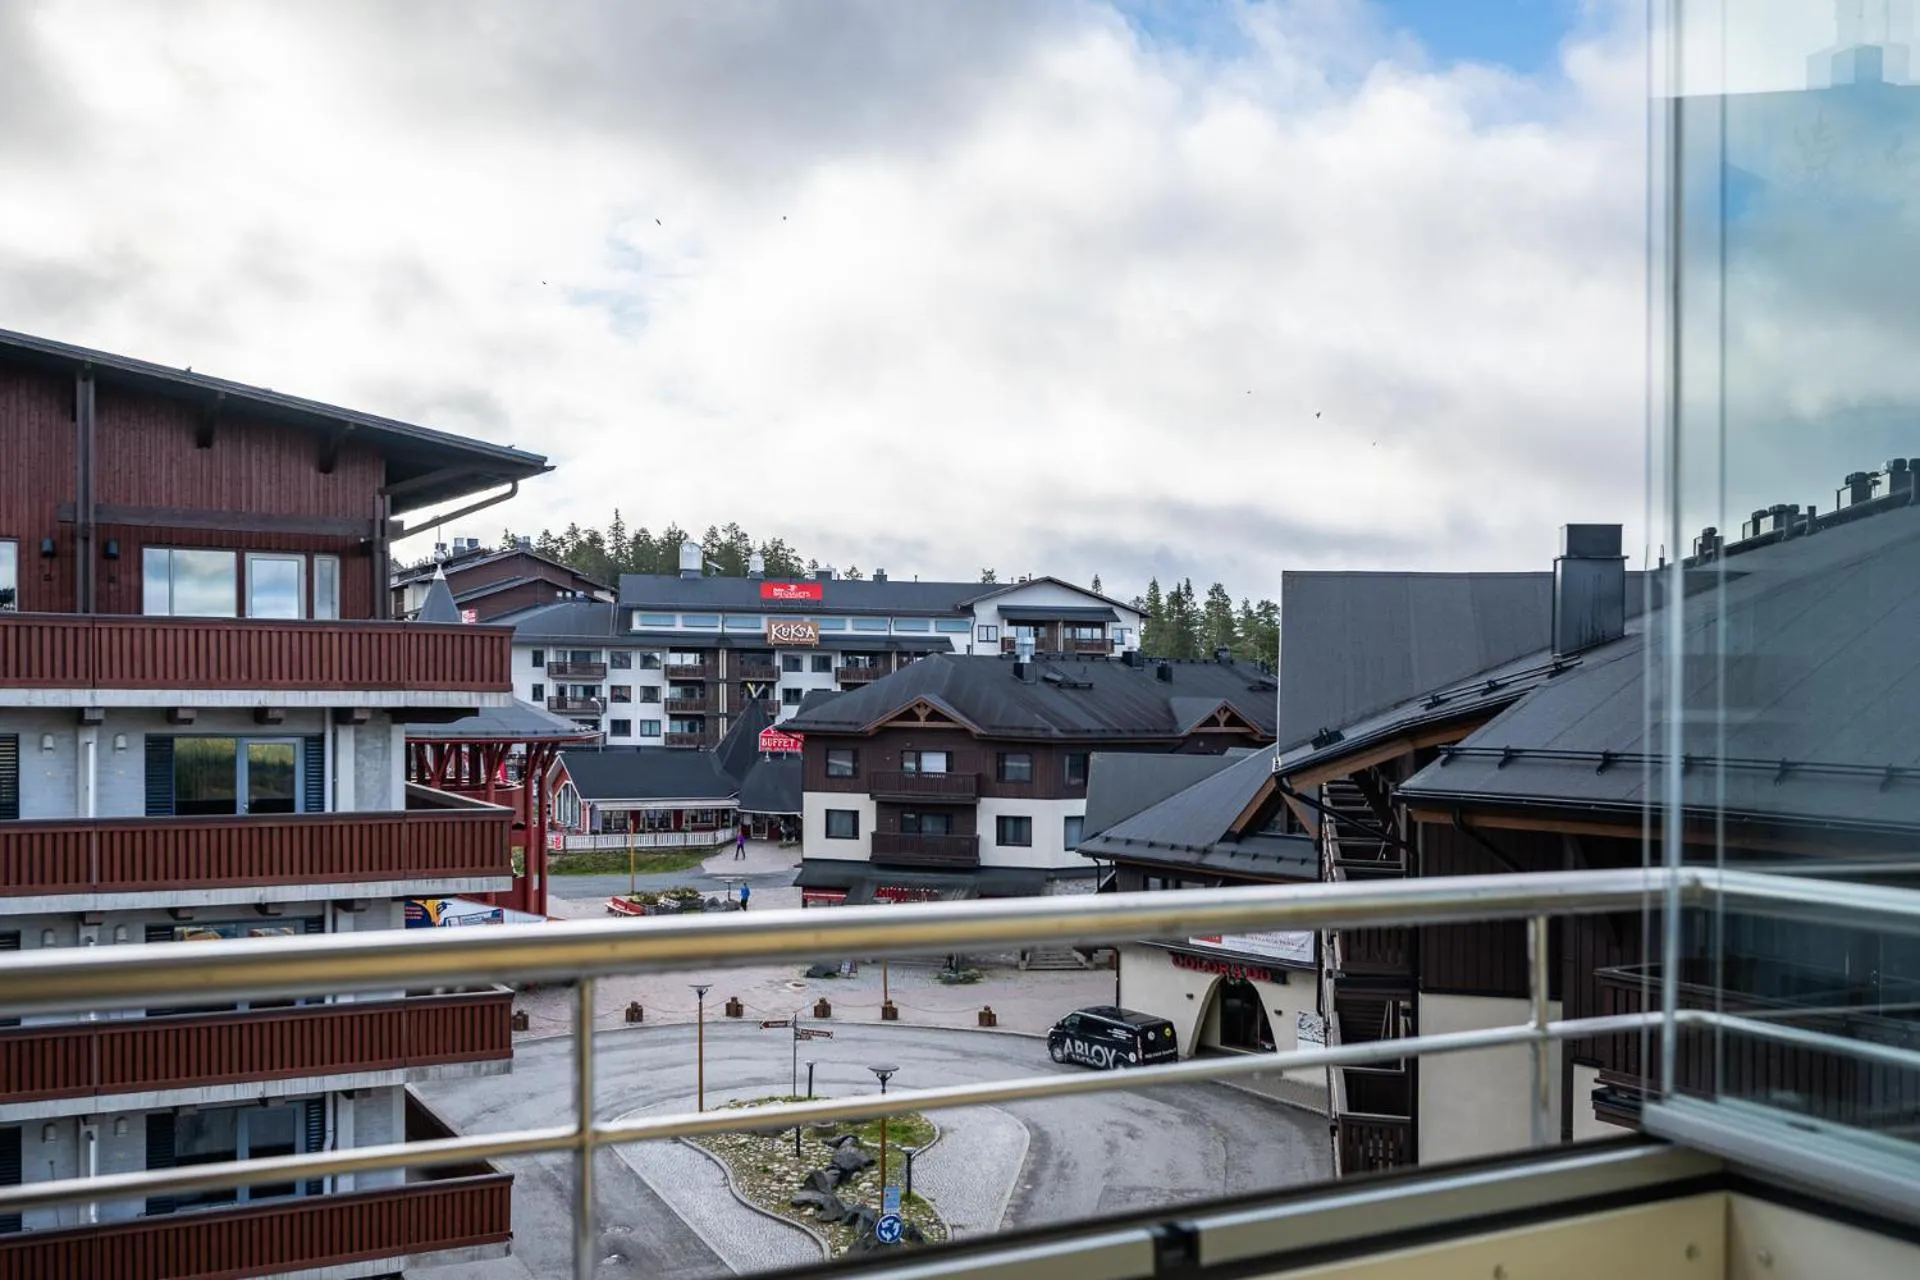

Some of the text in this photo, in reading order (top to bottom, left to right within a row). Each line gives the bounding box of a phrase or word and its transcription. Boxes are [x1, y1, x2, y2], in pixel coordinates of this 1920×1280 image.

[771, 624, 816, 641] KUKSA
[762, 738, 795, 748] BUFFET
[1171, 953, 1273, 981] COLORADO
